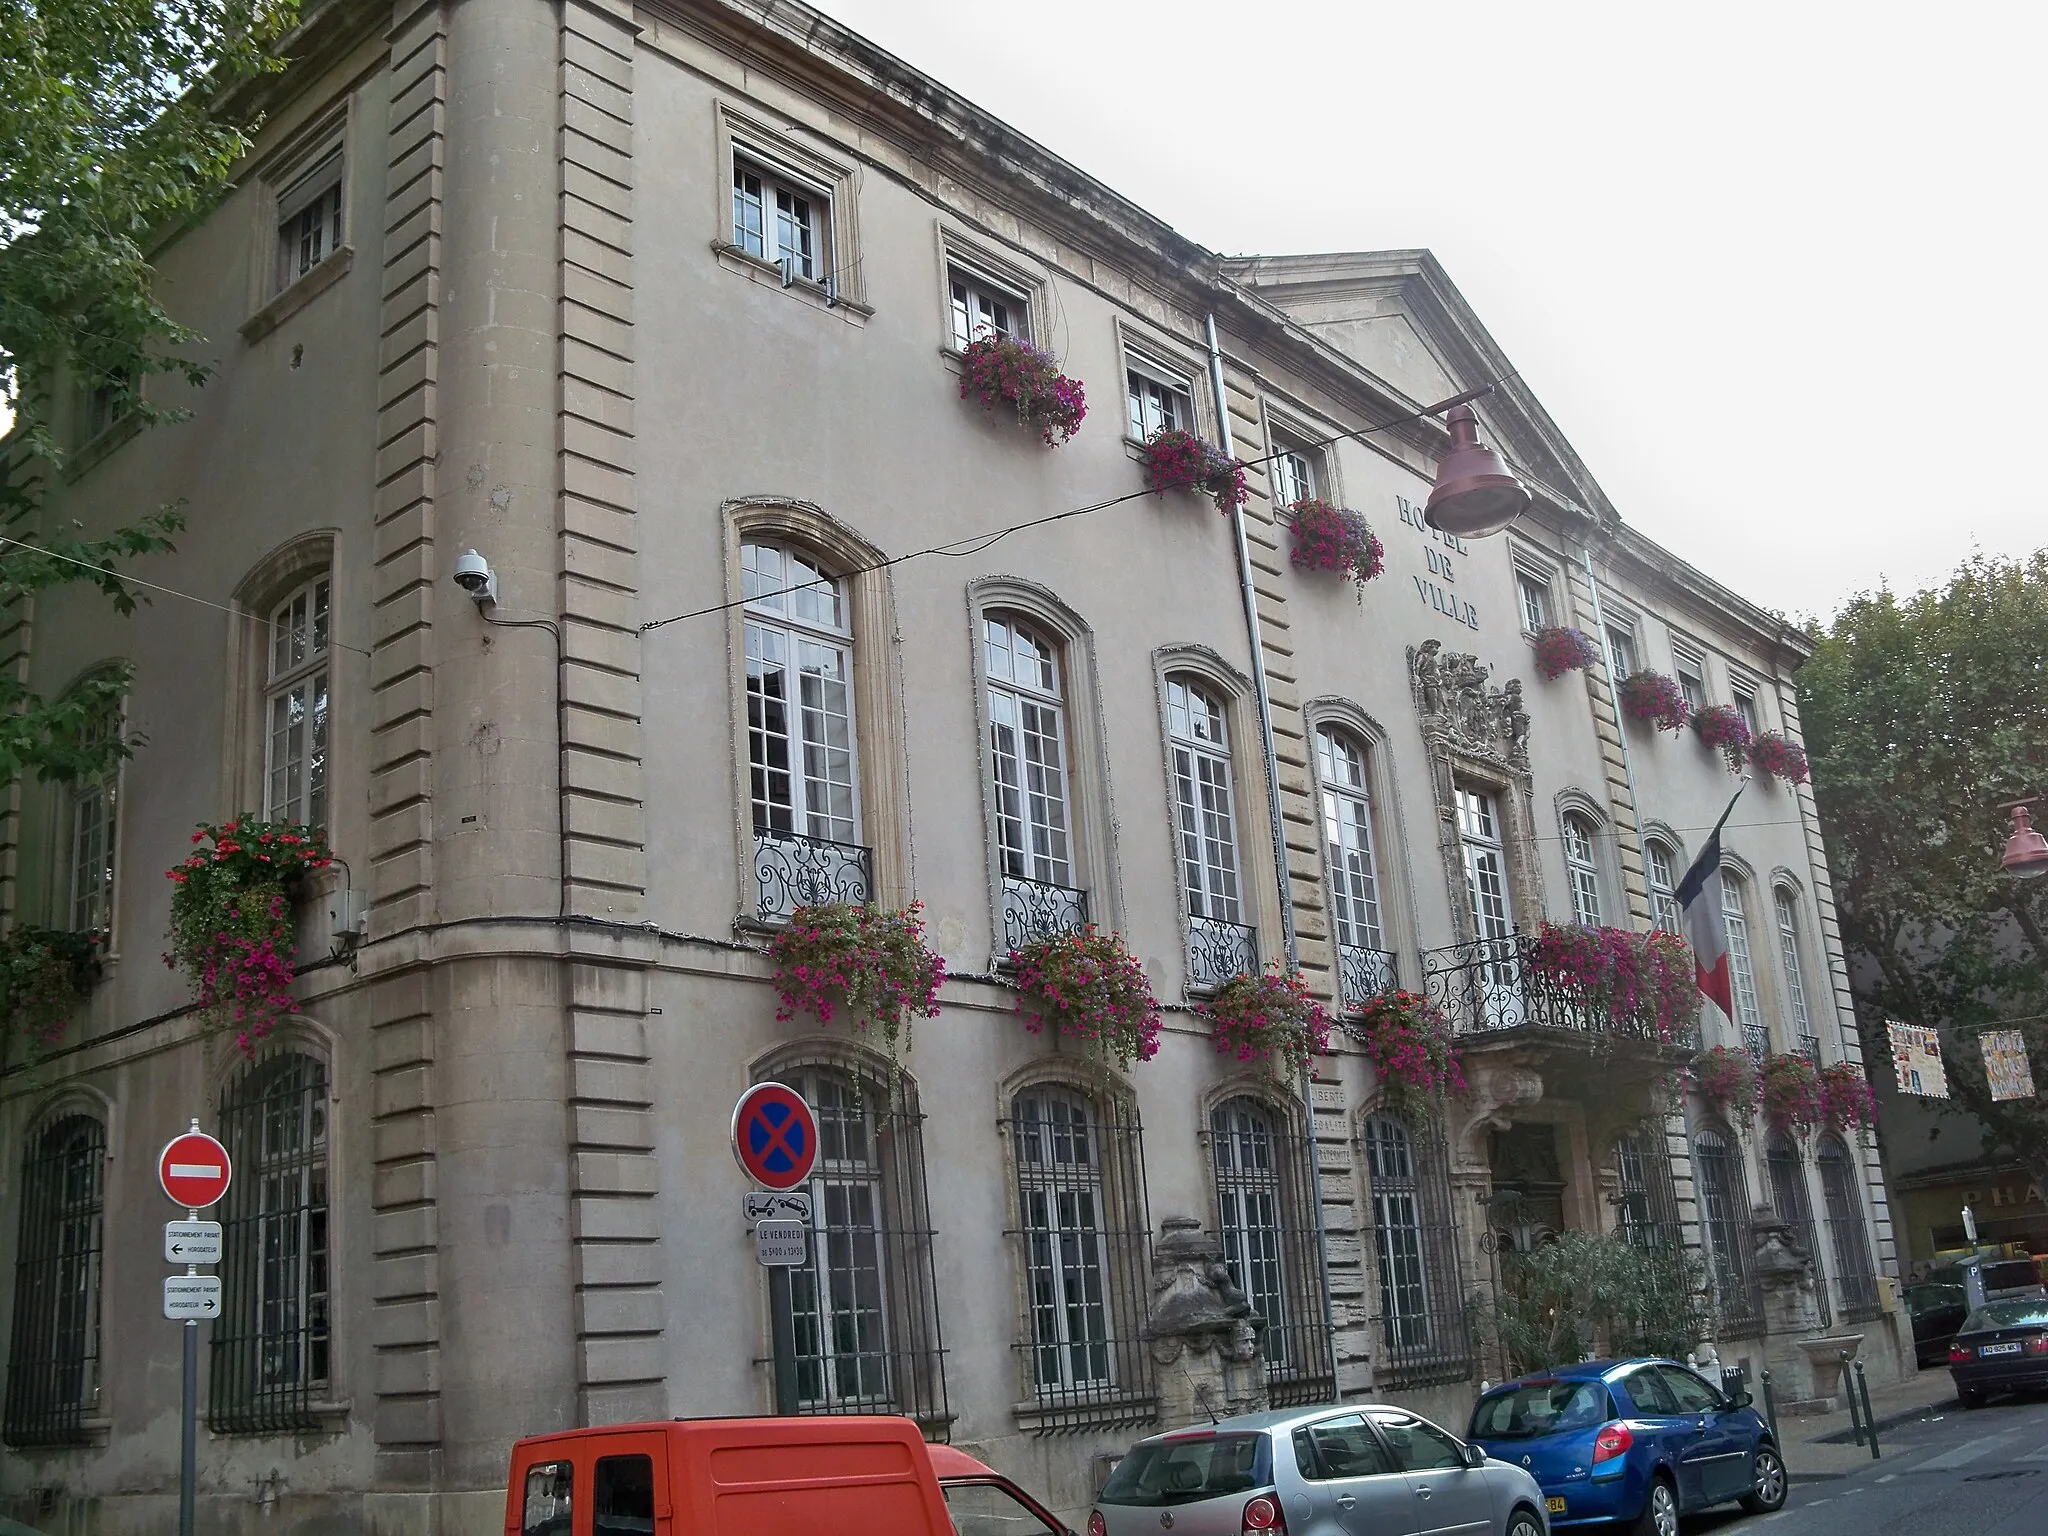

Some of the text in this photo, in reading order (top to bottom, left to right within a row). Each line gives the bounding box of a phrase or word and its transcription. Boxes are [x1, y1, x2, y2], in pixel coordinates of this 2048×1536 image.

[1424, 545, 1455, 584] DE
[1413, 575, 1479, 631] VILLE
[760, 1230, 803, 1239] LE VENDREDI
[1550, 1499, 1563, 1510] 84
